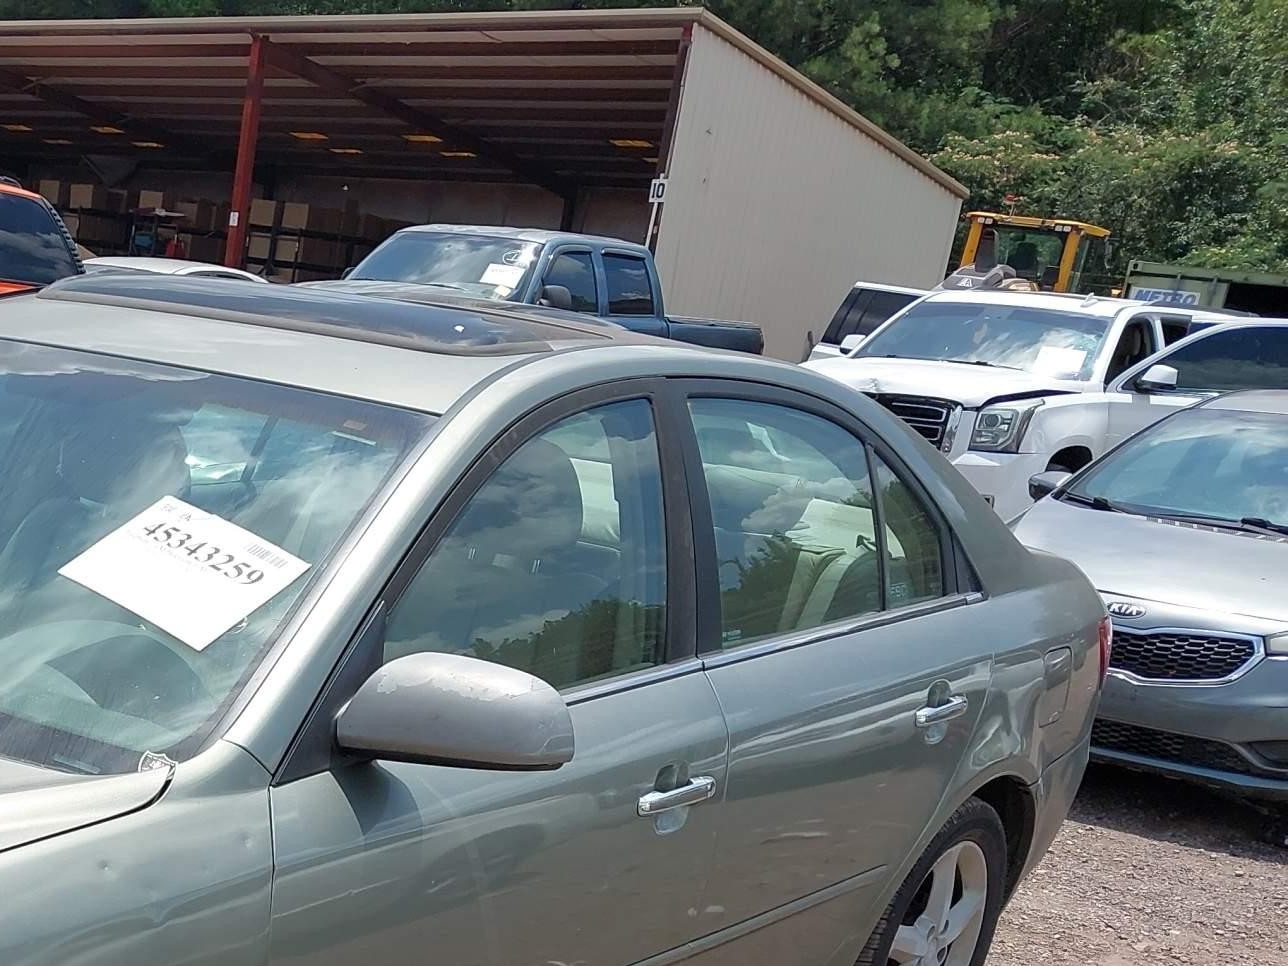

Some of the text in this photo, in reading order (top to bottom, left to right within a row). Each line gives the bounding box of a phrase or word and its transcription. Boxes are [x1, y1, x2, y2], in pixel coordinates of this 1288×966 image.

[651, 183, 665, 198] 10
[1136, 290, 1198, 305] METRO
[143, 522, 265, 584] 45343259
[1109, 603, 1143, 616] KIA
